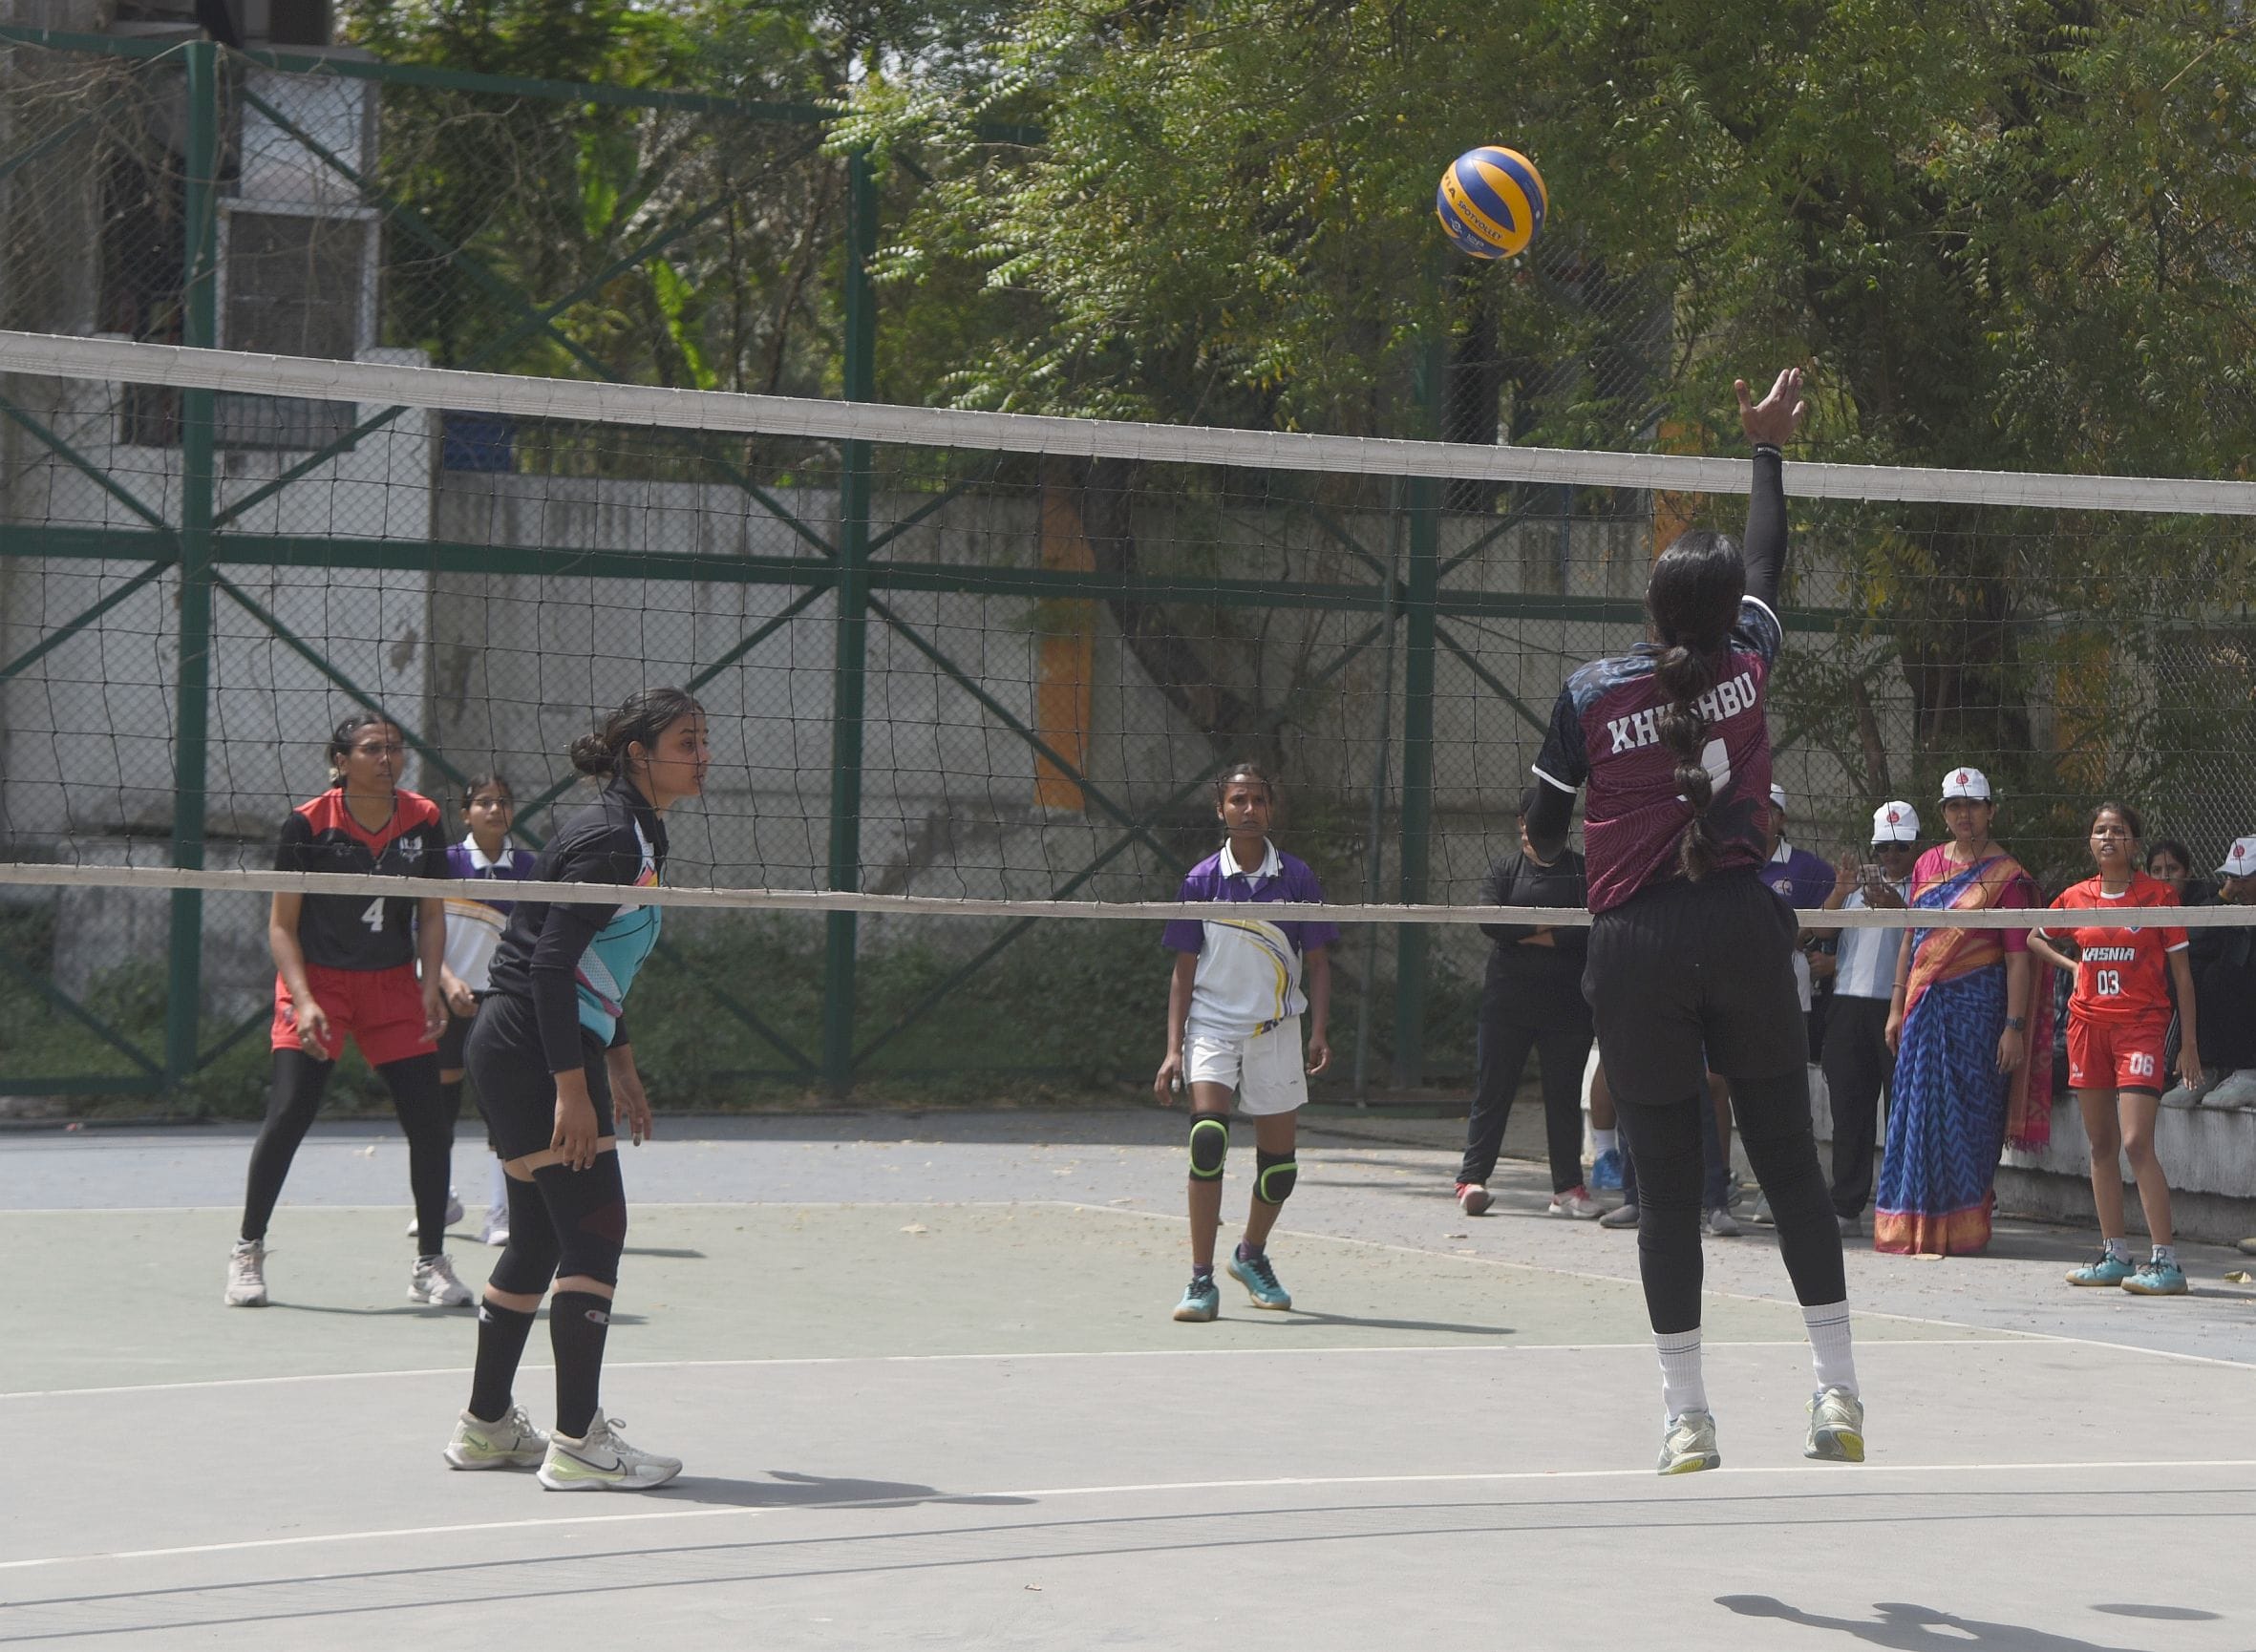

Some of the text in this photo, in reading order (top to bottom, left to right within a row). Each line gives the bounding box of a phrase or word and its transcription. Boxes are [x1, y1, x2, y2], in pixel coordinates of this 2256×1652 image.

[1607, 672, 1756, 753] KHHBU
[361, 897, 385, 932] 4
[2082, 946, 2136, 962] KASNIA
[2097, 969, 2119, 995] 03
[2130, 1051, 2155, 1077] 06
